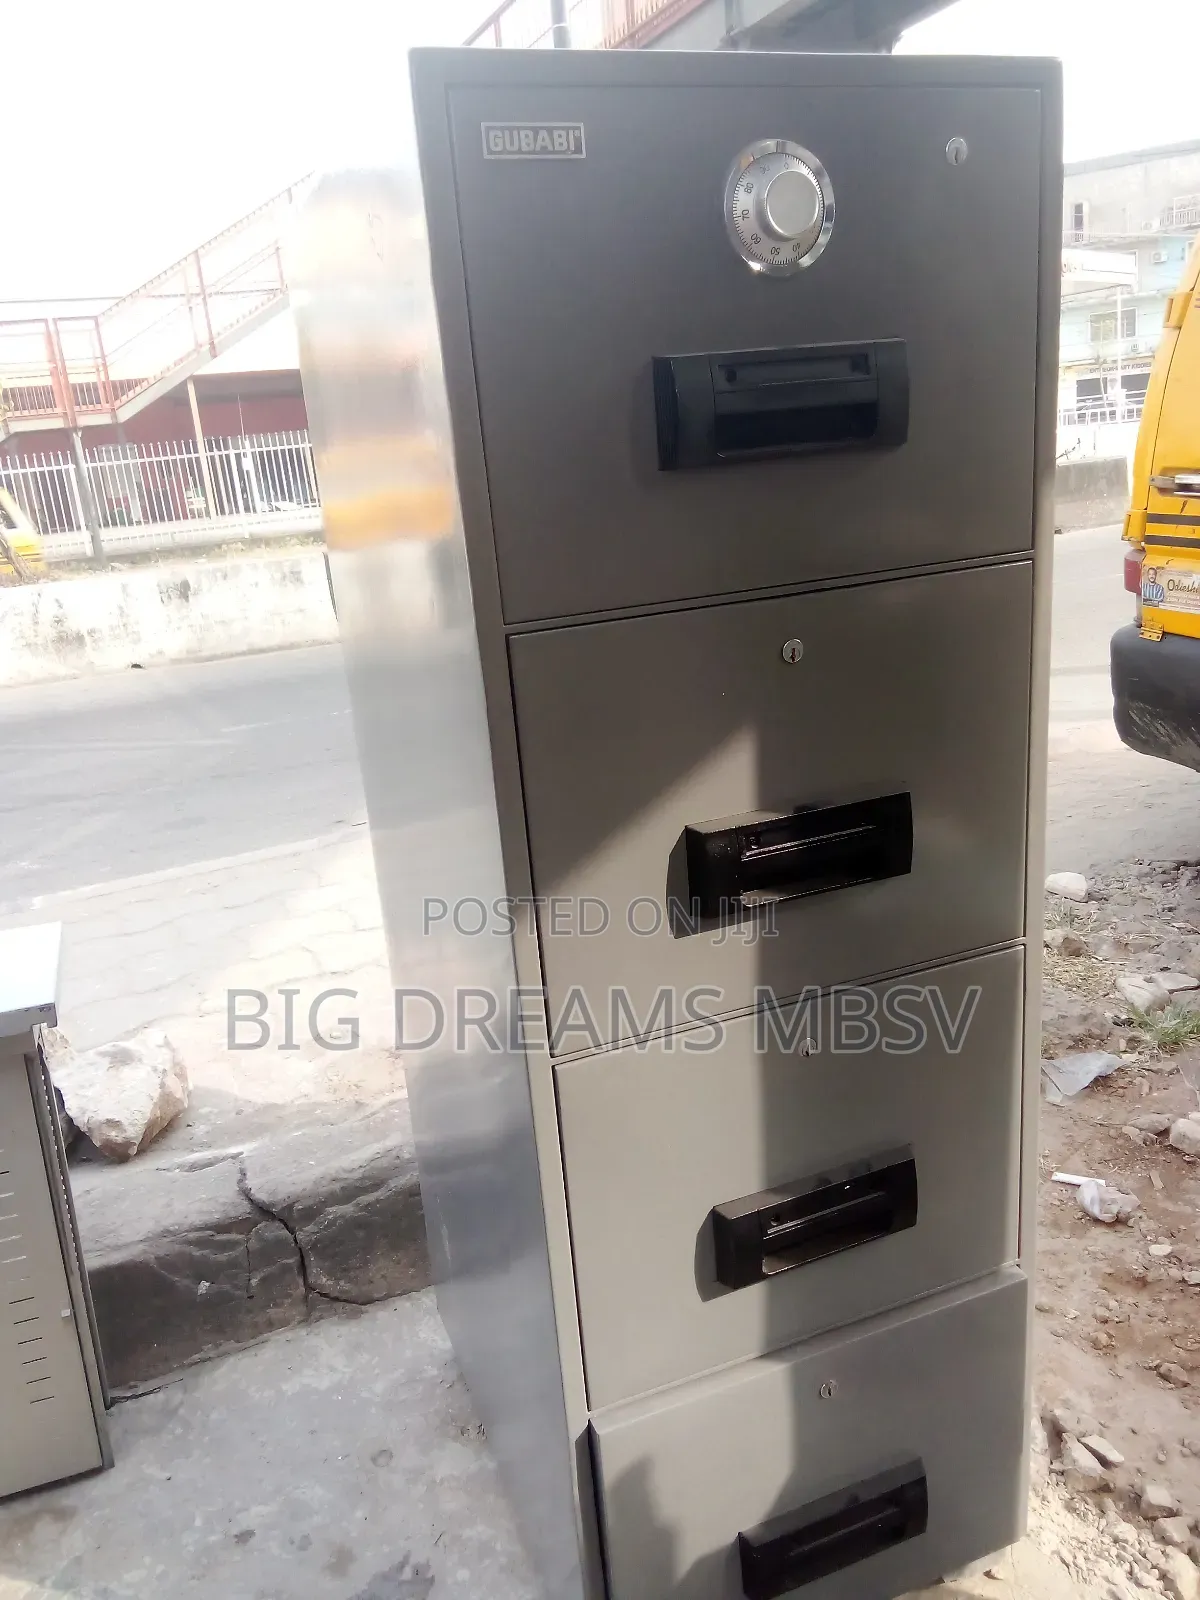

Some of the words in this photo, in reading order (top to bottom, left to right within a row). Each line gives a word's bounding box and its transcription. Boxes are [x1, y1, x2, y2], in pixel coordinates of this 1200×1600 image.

[488, 129, 575, 151] GUBABI
[744, 182, 754, 194] 80
[741, 209, 750, 221] 70
[750, 233, 762, 245] 60
[770, 246, 781, 256] 50
